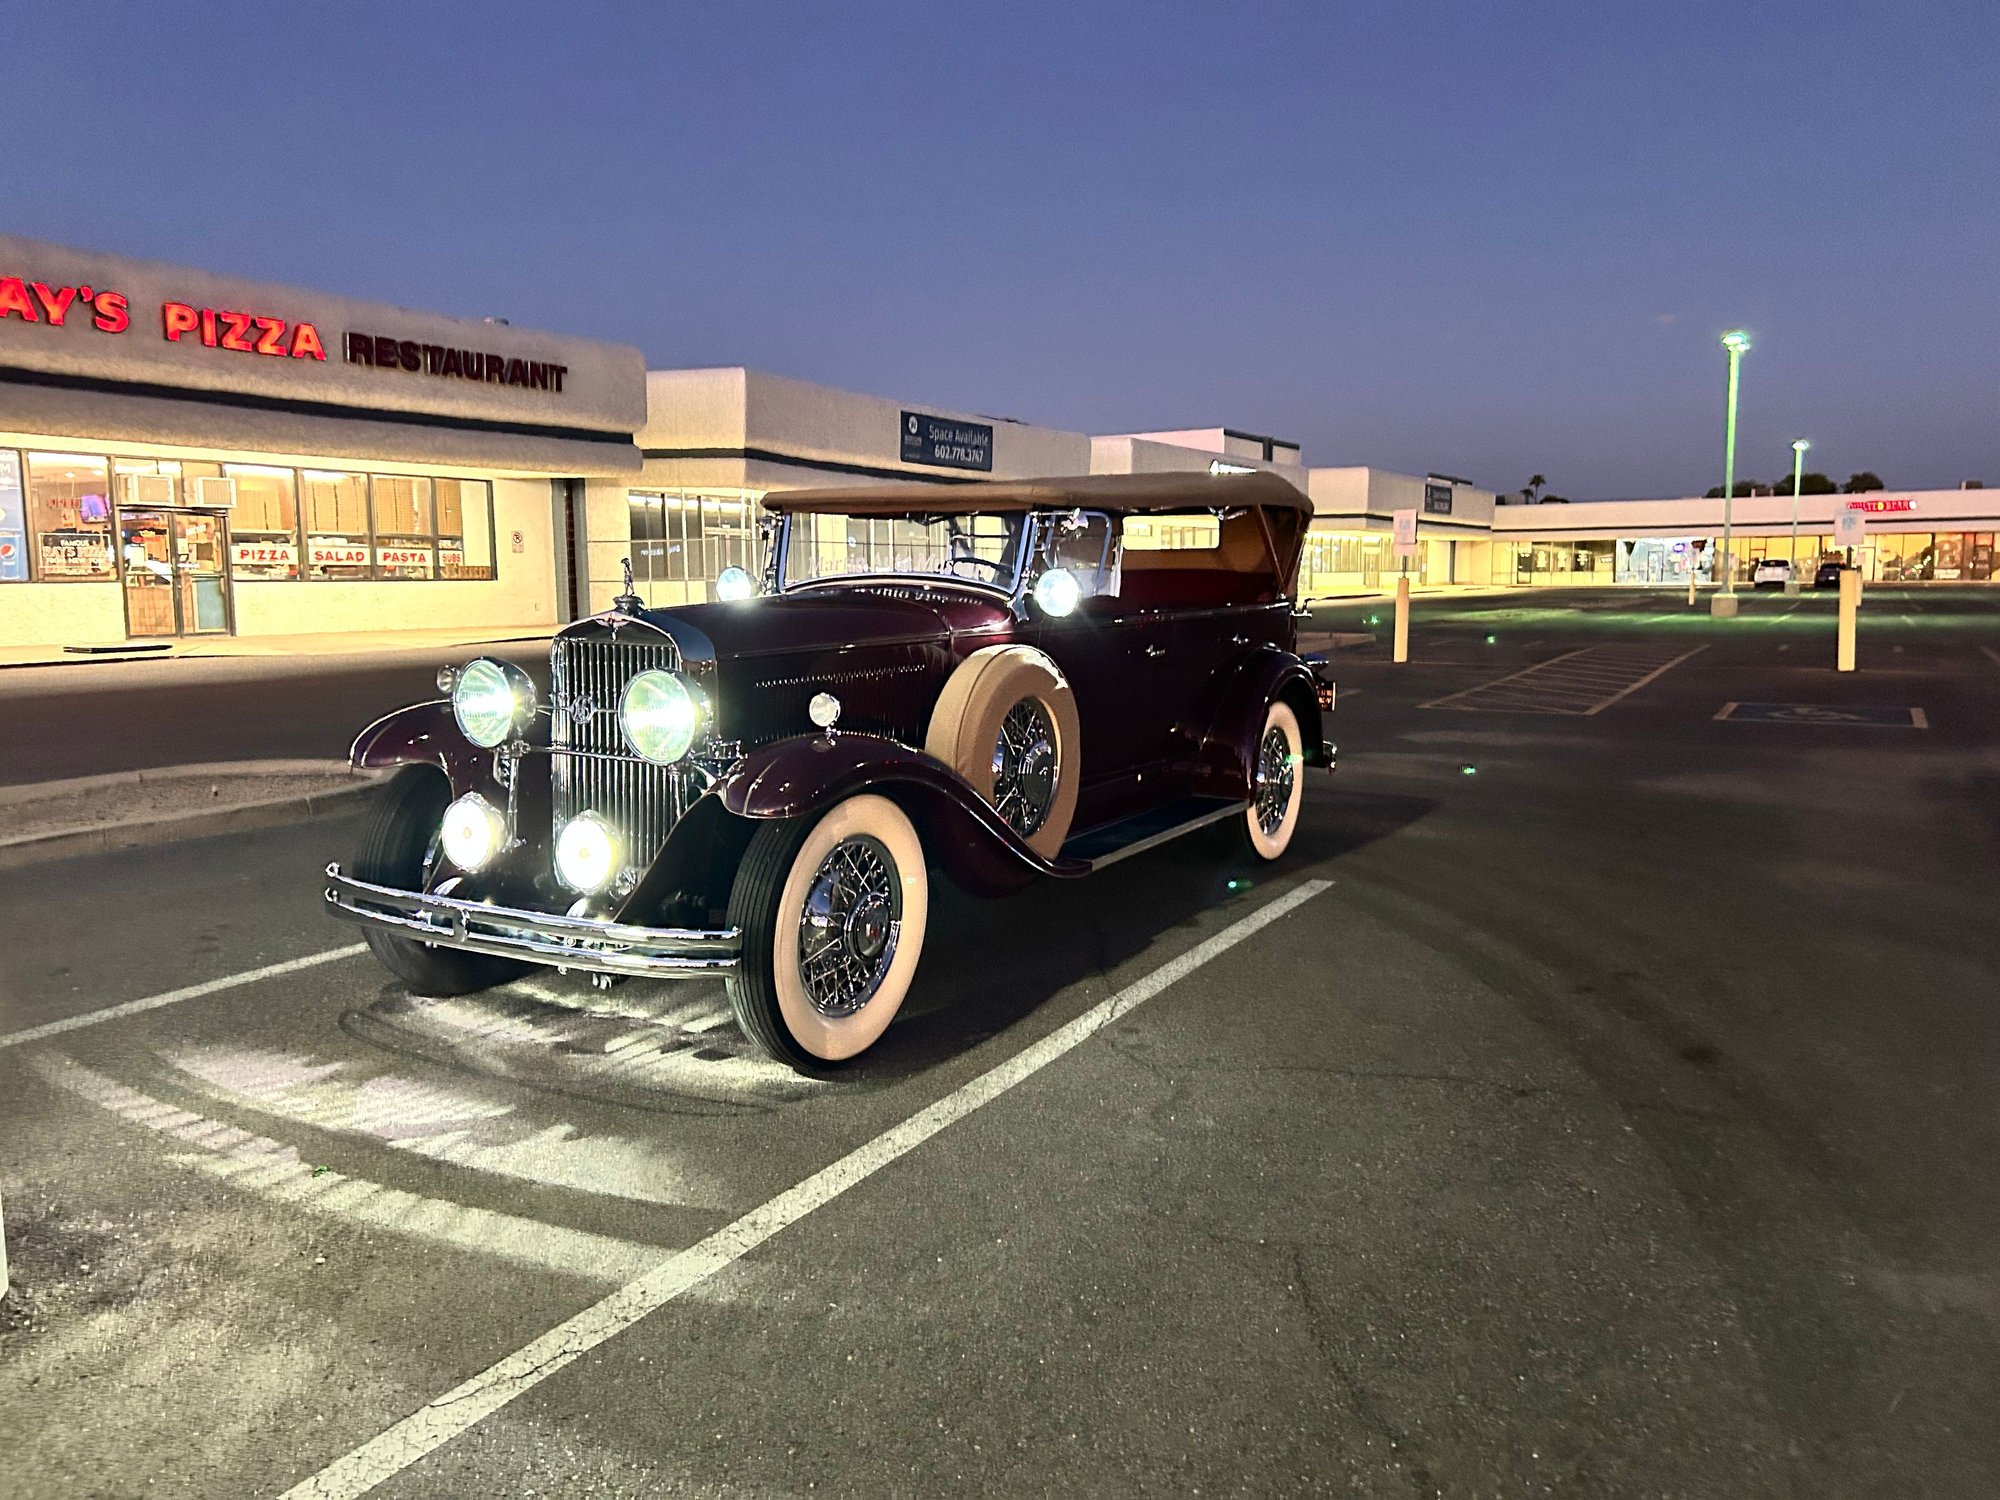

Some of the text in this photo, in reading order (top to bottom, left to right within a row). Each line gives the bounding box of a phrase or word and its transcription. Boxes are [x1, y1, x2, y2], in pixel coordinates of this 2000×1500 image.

[163, 302, 327, 361] PIZZA
[343, 331, 568, 392] RESTAURANT
[929, 424, 954, 442] Space
[954, 428, 989, 447] Available
[240, 549, 290, 560] PIZZA
[315, 551, 365, 562] SALAD
[383, 552, 427, 563] PASTA
[442, 553, 461, 563] SUBS
